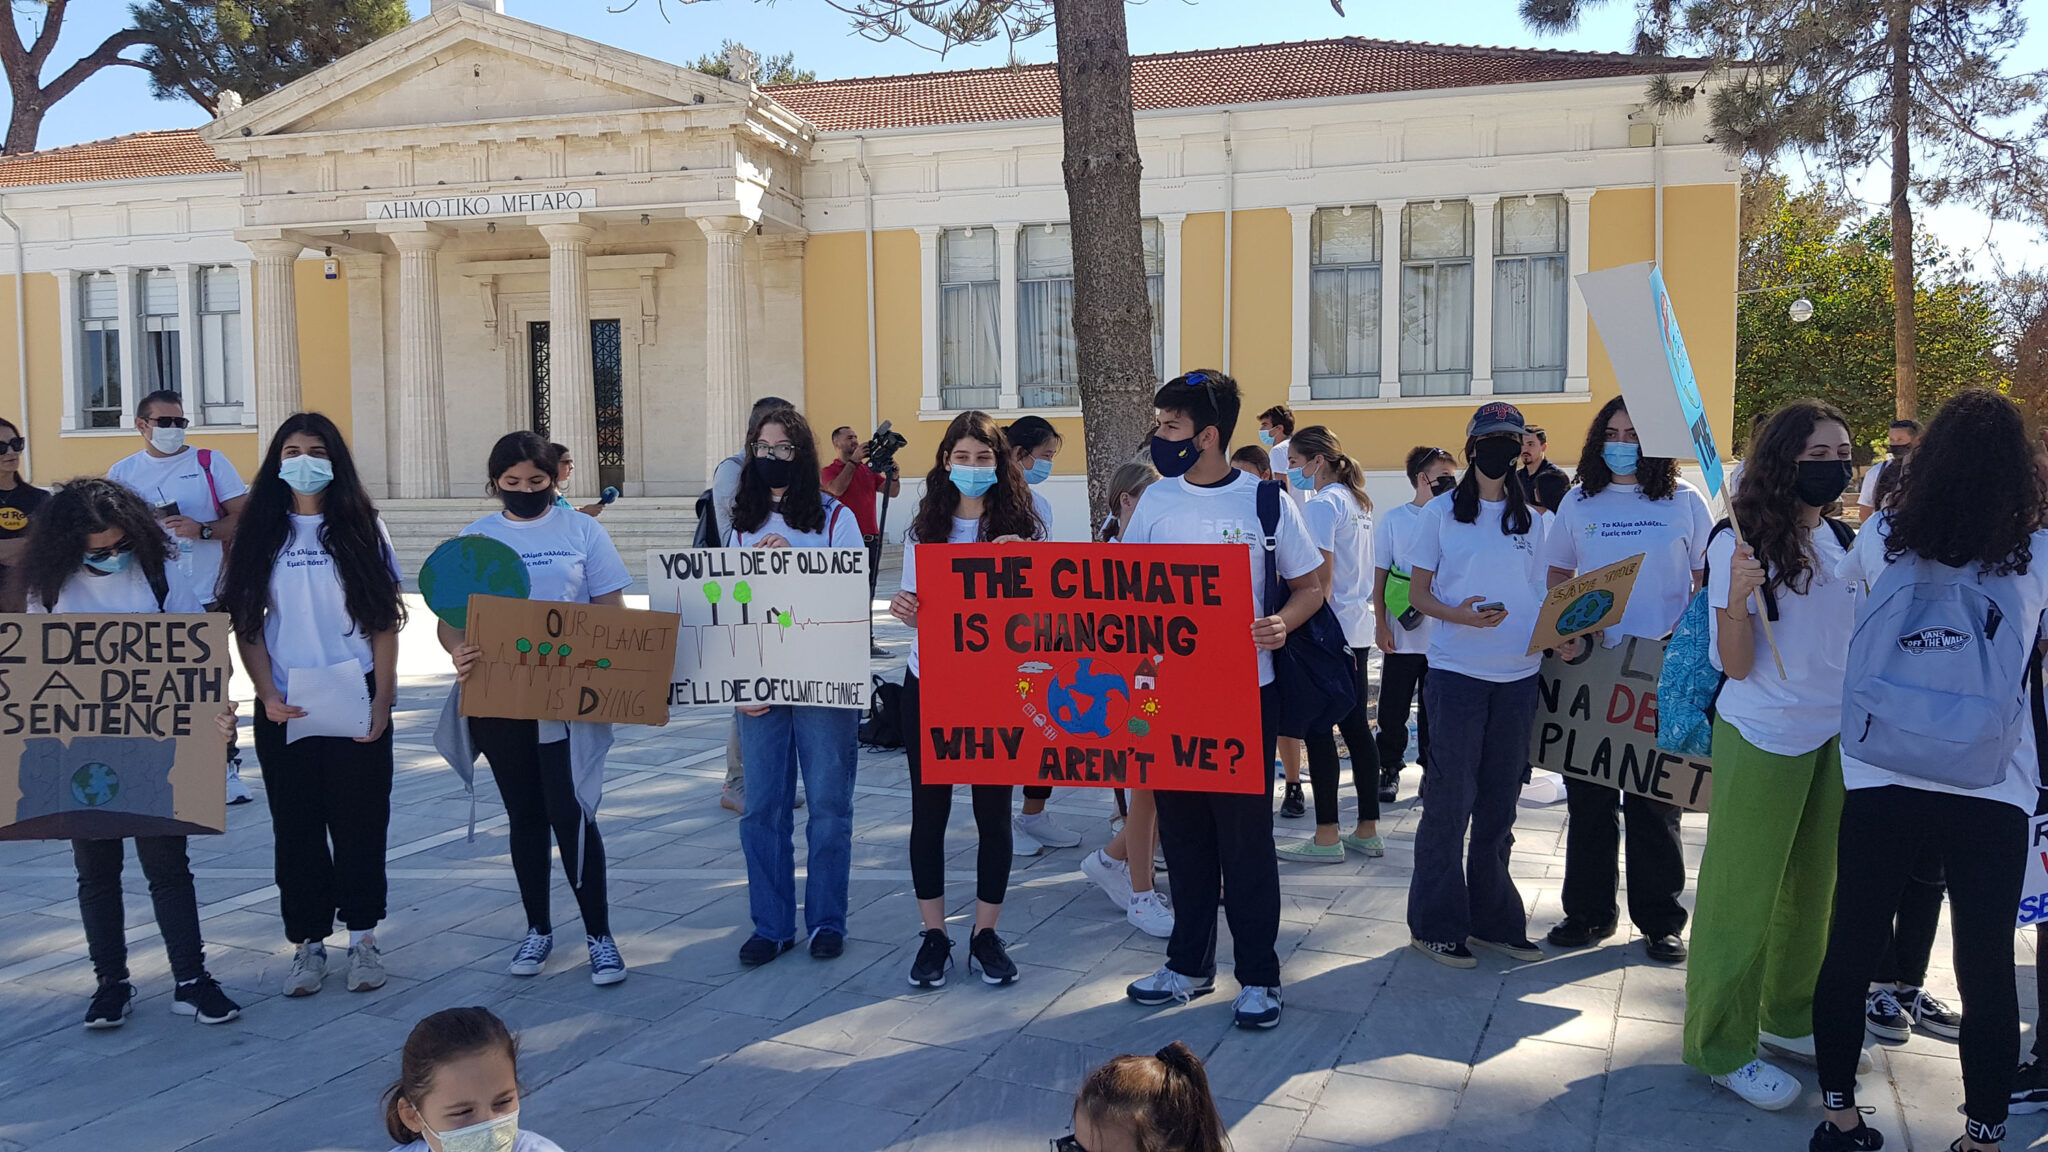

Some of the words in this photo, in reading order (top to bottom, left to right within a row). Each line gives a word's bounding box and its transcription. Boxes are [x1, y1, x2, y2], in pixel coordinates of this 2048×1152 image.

[659, 550, 735, 580] YOU'LL
[740, 551, 767, 575] DIE
[771, 551, 793, 574] OF
[797, 551, 828, 574] OLD
[831, 550, 863, 574] AGE
[952, 556, 1033, 599] THE
[1050, 558, 1222, 606] CLIMATE
[1552, 578, 1597, 602] SAVE
[1604, 562, 1637, 584] THE
[0, 622, 27, 664] 2
[42, 621, 211, 665] DEGREES
[546, 608, 591, 638] OUR
[591, 624, 672, 651] PLANET
[953, 613, 990, 652] IS
[1005, 612, 1198, 655] CHANGING
[1920, 630, 1945, 640] VANS
[1922, 638, 1940, 647] THE
[32, 670, 85, 701] A
[101, 667, 222, 705] DEATH
[546, 687, 565, 711] IS
[578, 686, 645, 718] DYING
[721, 679, 752, 703] DIE
[754, 677, 780, 701] OF
[781, 679, 823, 703] CLIMATE
[826, 681, 864, 705] CHANGE
[3, 702, 192, 737] SENTENCE
[1569, 684, 1590, 721] A
[1606, 683, 1658, 733] DE
[930, 727, 1024, 760] WHY
[1037, 746, 1155, 784] AREN'T
[1171, 734, 1245, 775] WE?
[1538, 722, 1712, 805] PLANET
[2018, 893, 2048, 923] SE
